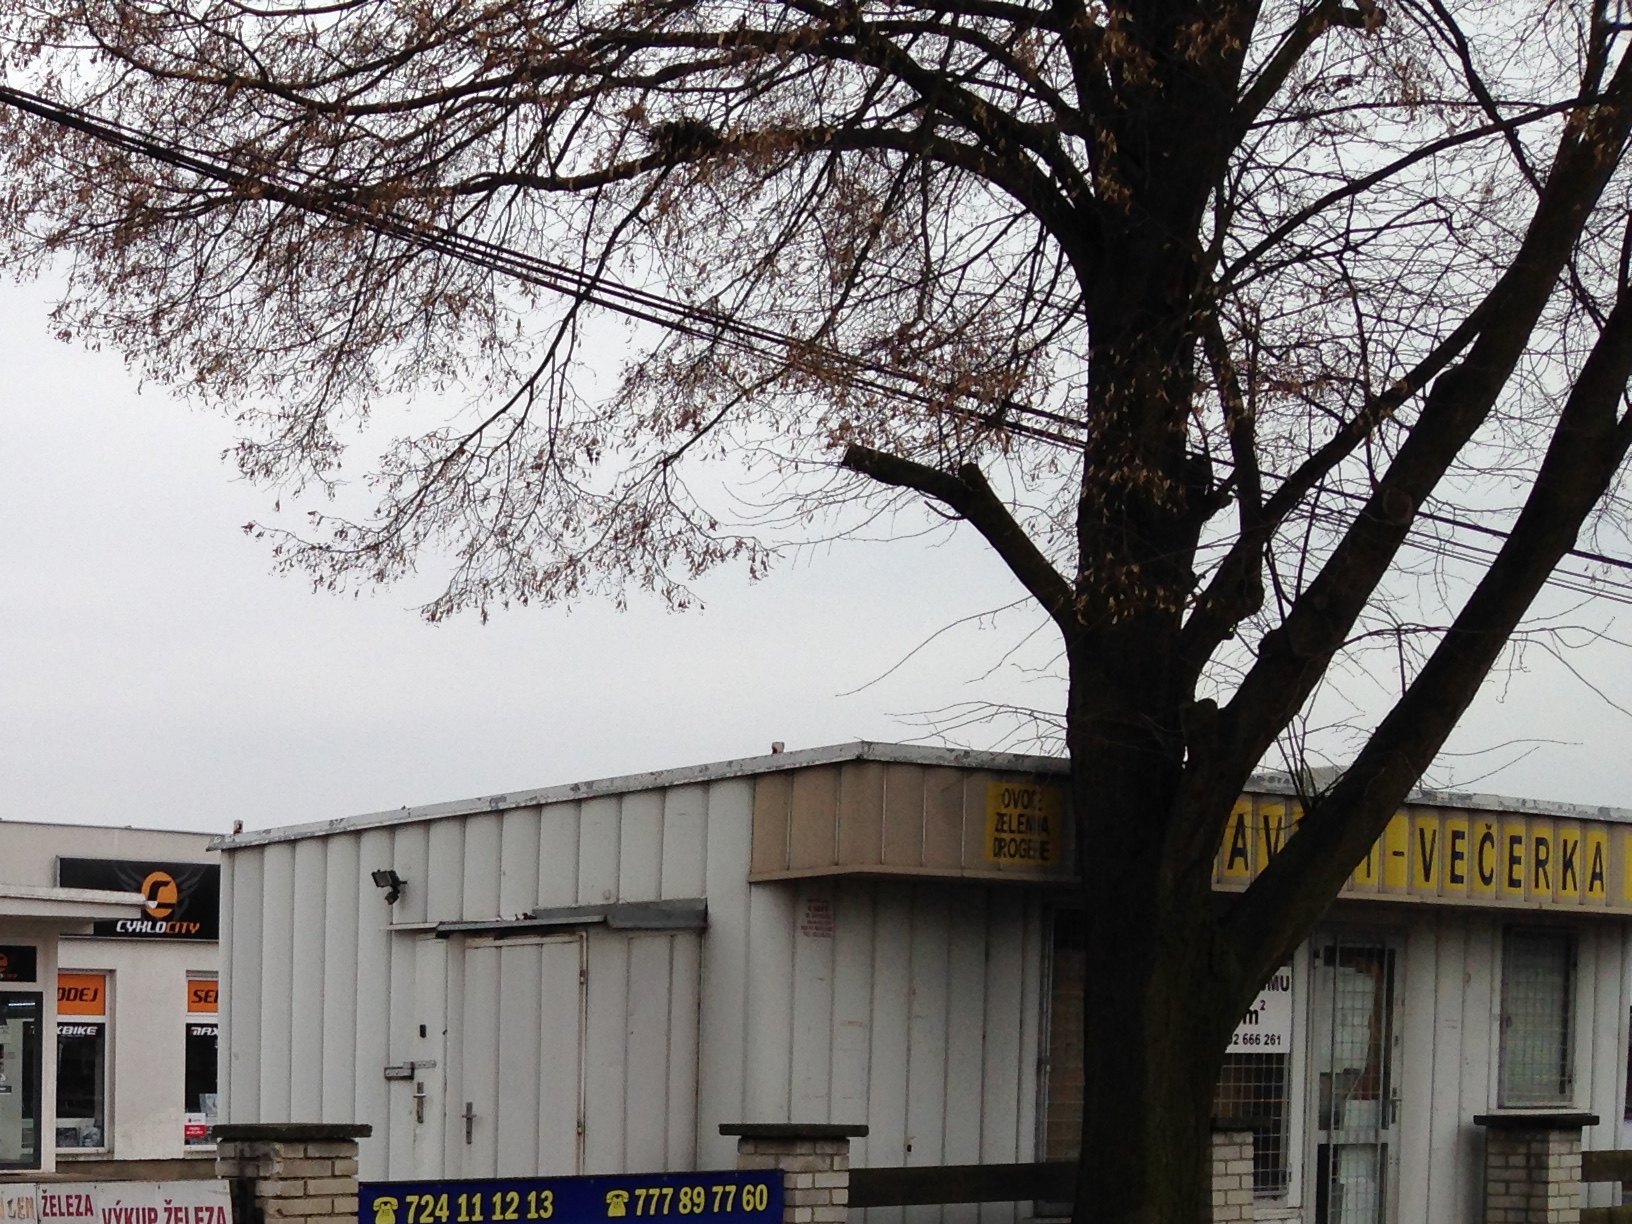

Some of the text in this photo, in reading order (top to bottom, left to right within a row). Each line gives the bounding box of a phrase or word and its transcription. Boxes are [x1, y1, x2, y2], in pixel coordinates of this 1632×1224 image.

[116, 920, 200, 934] CYKLOCITY
[1243, 1033, 1261, 1046] 666
[1264, 1033, 1282, 1046] 261
[42, 1189, 94, 1217] ŽELEZA
[406, 1190, 553, 1224] 724 11 12 13
[635, 1184, 768, 1216] 777 89 77 60
